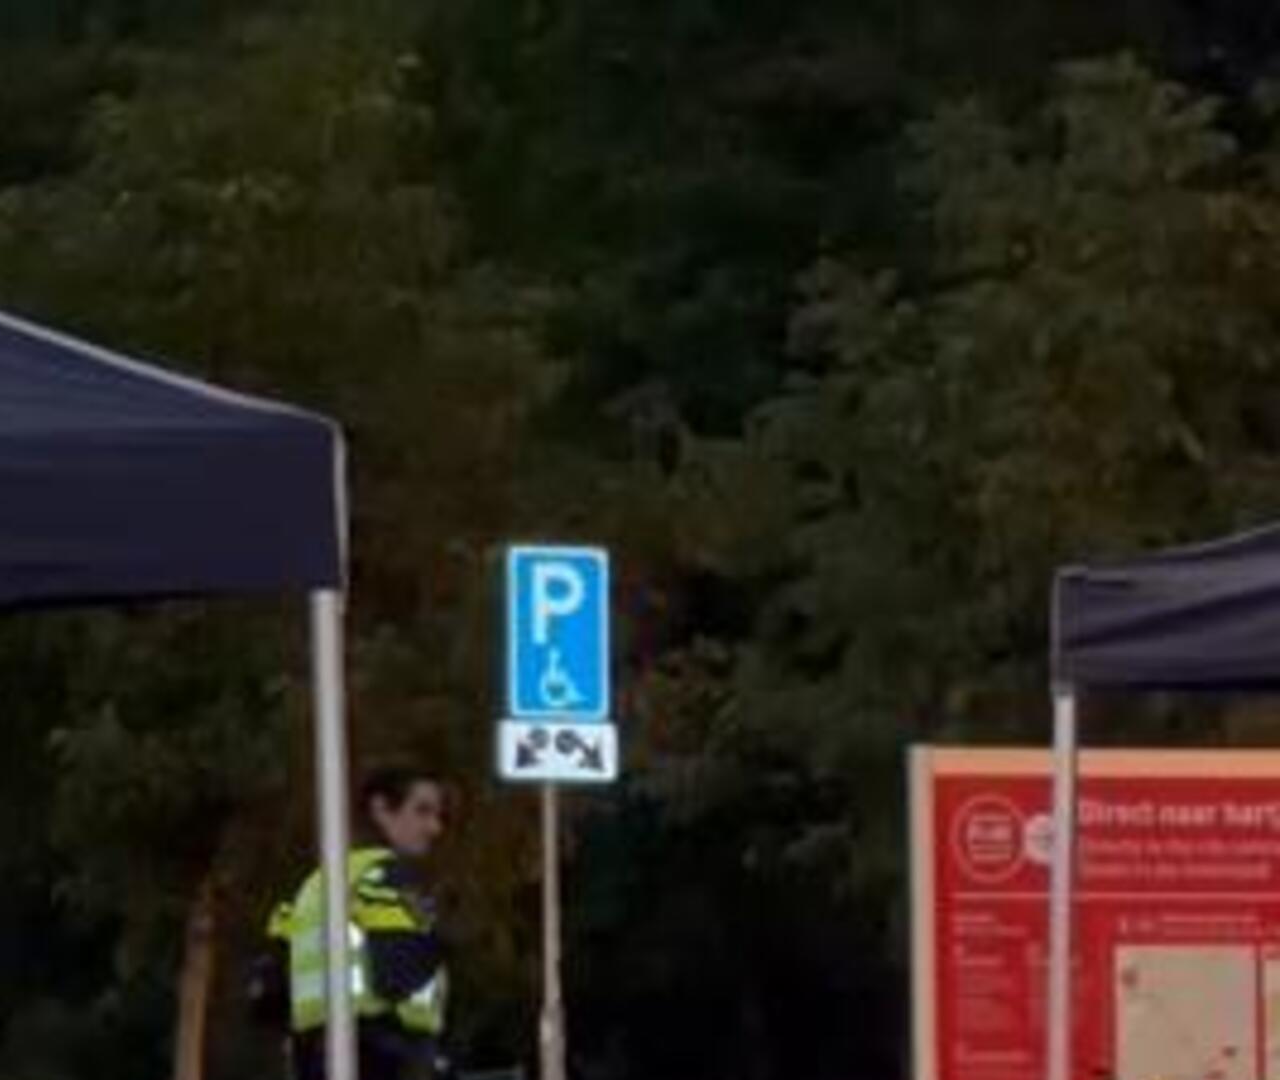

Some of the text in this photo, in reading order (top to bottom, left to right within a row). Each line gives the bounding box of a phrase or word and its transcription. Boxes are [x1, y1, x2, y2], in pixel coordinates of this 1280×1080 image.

[532, 562, 584, 645] P
[1077, 799, 1153, 825] Direct
[1158, 803, 1217, 826] naar
